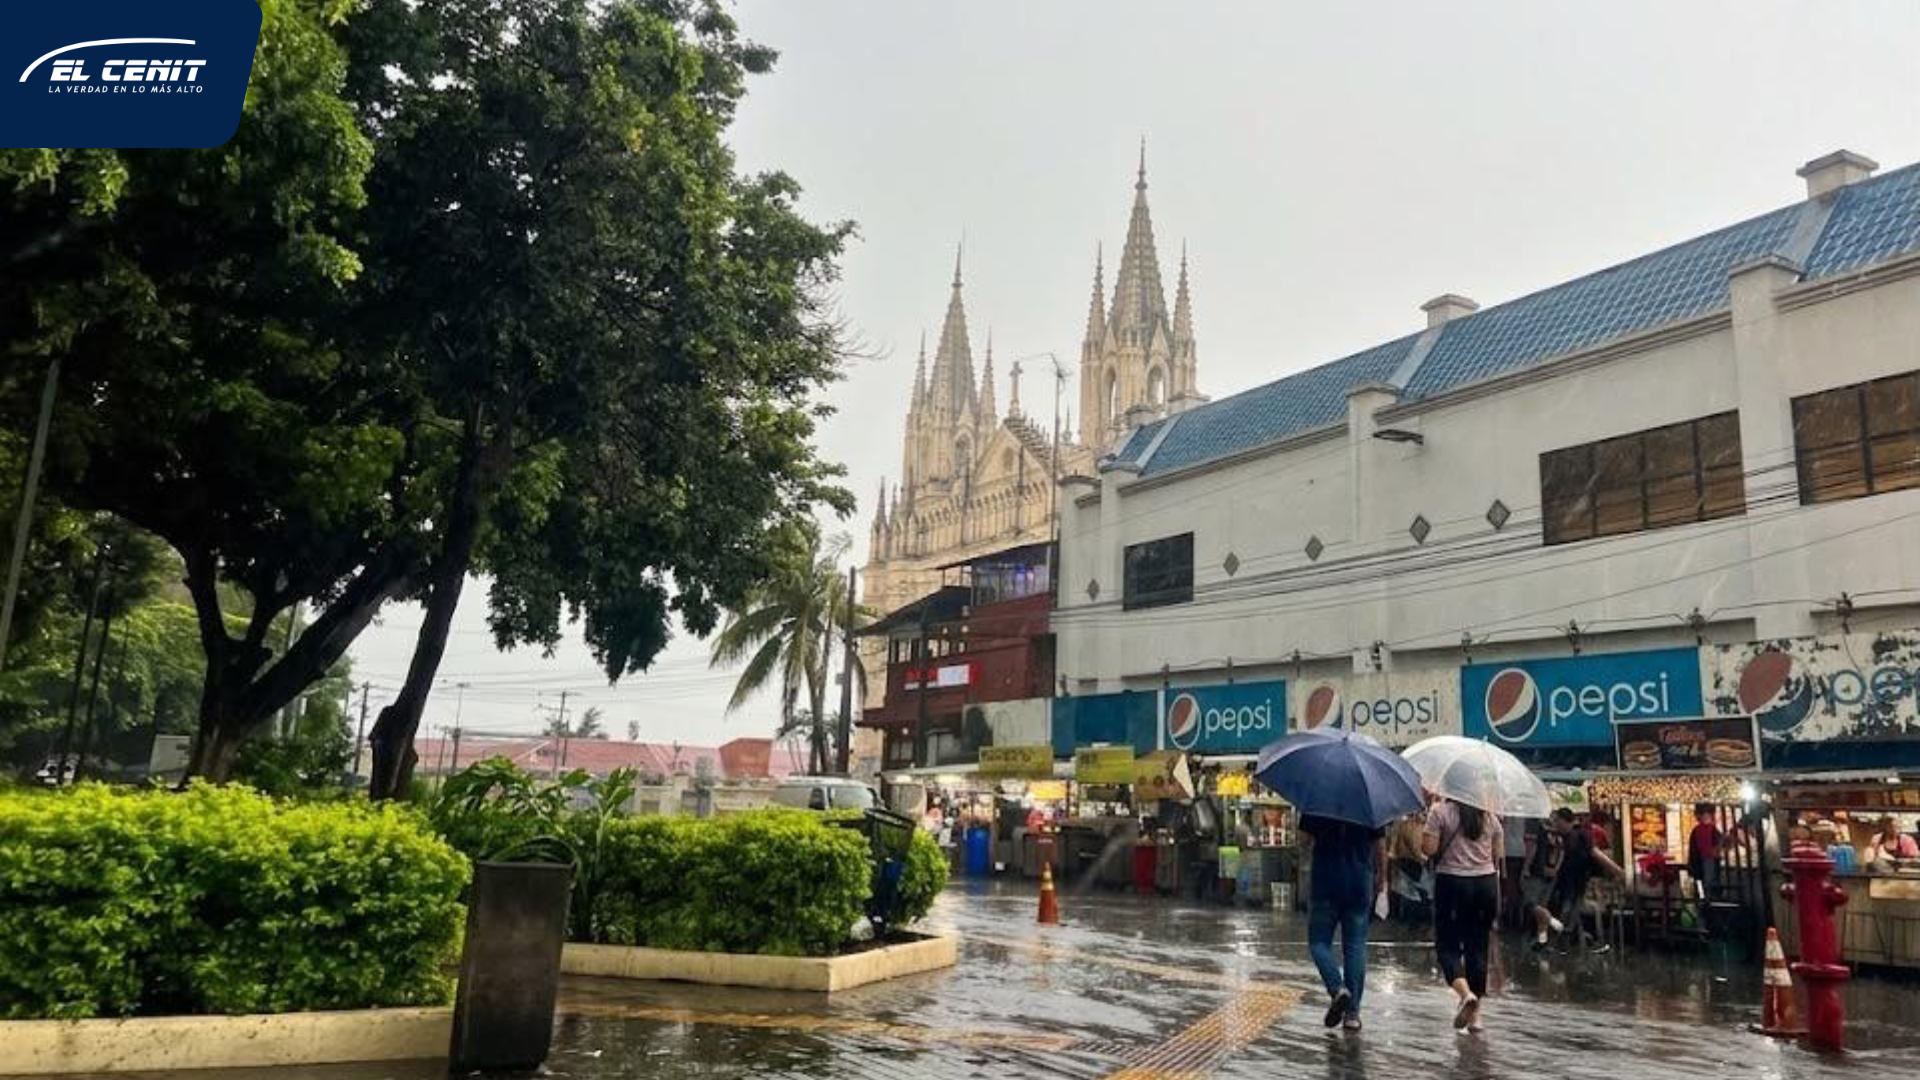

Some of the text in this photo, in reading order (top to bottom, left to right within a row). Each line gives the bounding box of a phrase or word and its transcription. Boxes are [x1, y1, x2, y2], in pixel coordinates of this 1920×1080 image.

[1351, 689, 1438, 734] pepsi
[1550, 671, 1669, 726] pepsi
[1822, 665, 1920, 717] pe
[1205, 698, 1271, 739] pepsi
